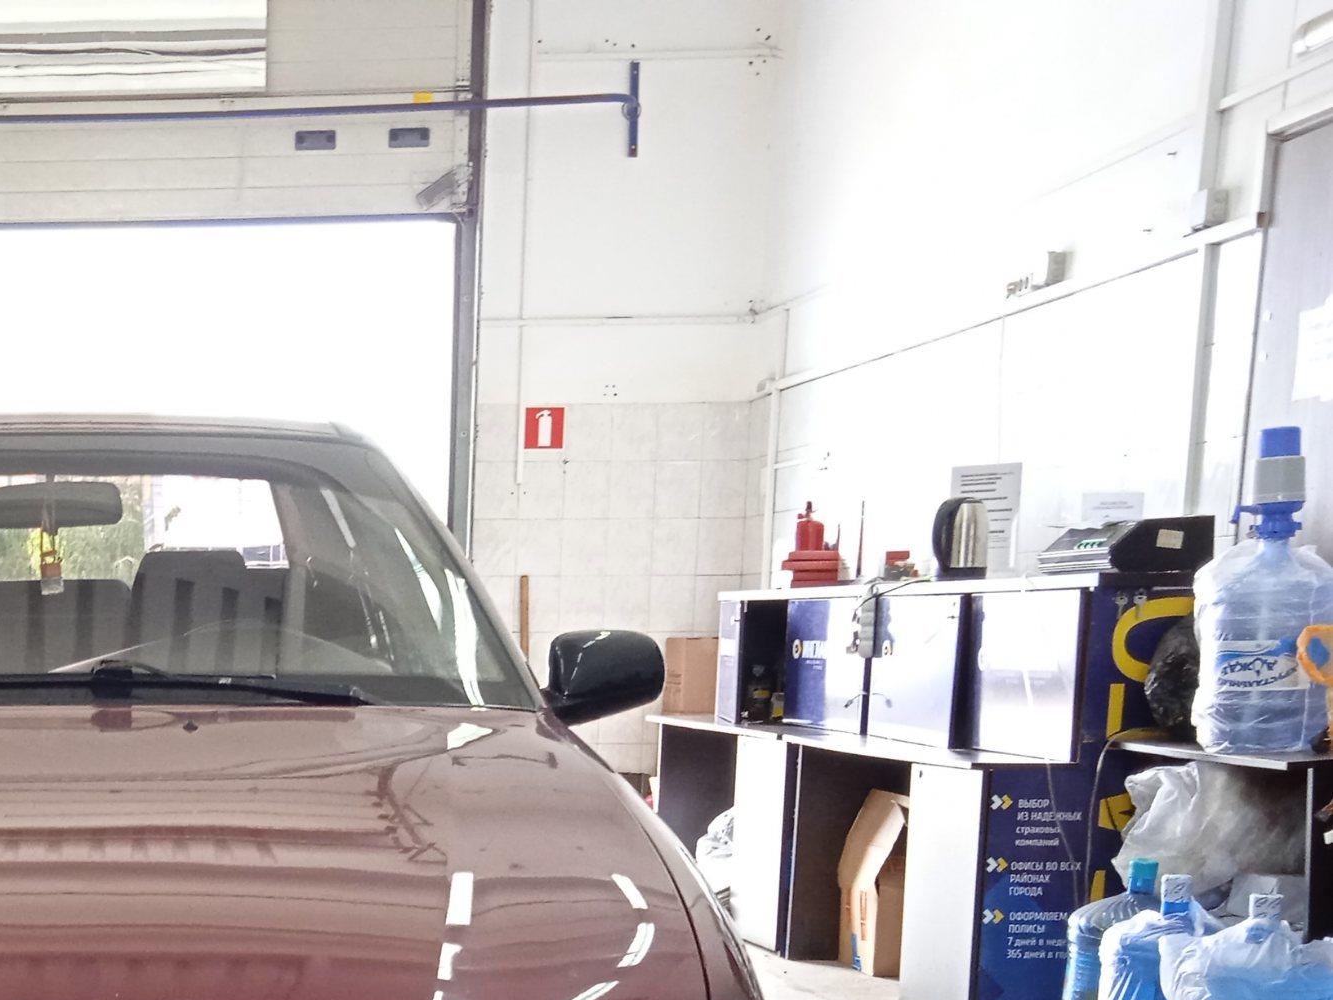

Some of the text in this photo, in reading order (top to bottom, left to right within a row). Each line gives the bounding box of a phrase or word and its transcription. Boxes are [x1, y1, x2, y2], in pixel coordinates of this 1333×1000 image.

[1018, 798, 1050, 809] ВЫБОР
[1017, 811, 1082, 822] ИЗ НАДЕЖНЫХ
[1015, 838, 1059, 847] компаний
[1010, 861, 1044, 871] ОФИСЫ
[1045, 861, 1058, 871] ВО
[1009, 872, 1050, 883] РАЙОНАХ
[1008, 886, 1043, 896] ГОРОДА
[1009, 911, 1067, 921] ОФОРМЛЯЕМ
[1008, 924, 1045, 934] ПОЛИСЫ
[1007, 937, 1013, 946] 7
[1014, 938, 1036, 947] дней
[1006, 949, 1022, 959] 365
[1023, 949, 1045, 959] дней
